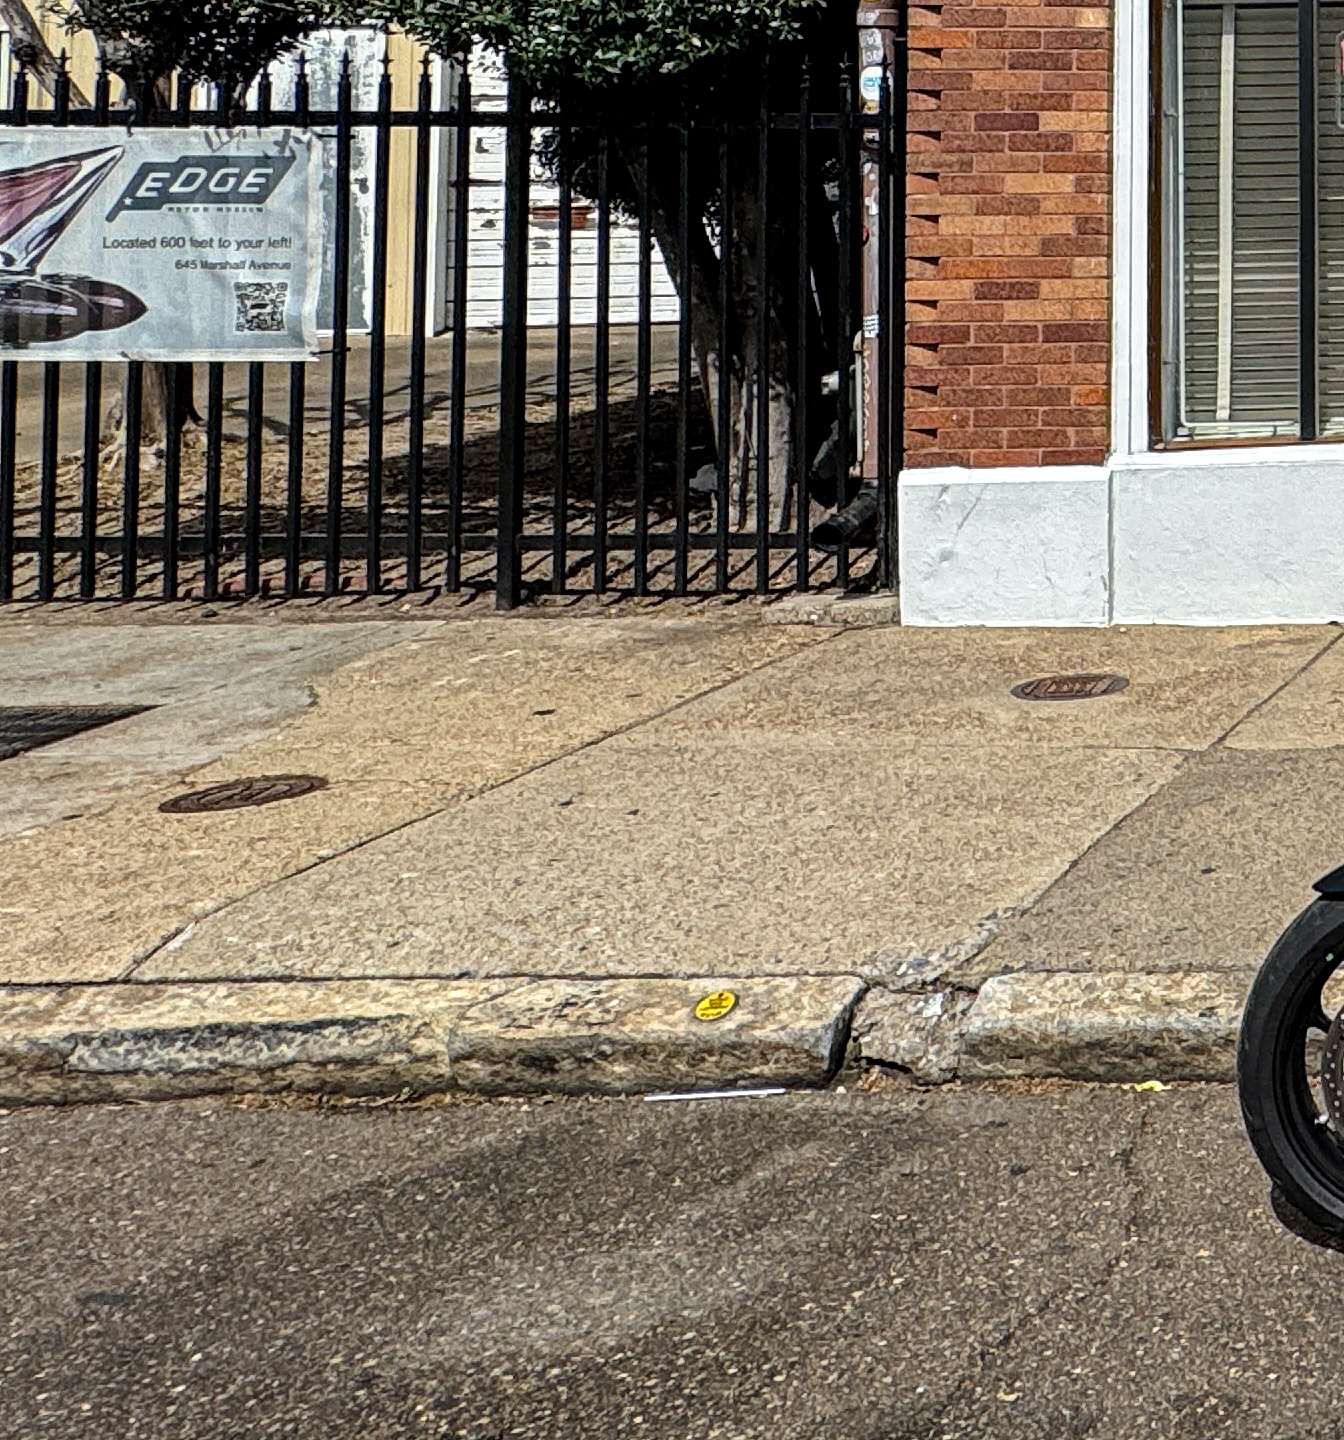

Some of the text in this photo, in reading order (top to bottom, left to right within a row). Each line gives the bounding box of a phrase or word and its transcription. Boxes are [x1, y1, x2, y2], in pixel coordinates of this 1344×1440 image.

[135, 167, 273, 198] EDGE
[102, 237, 157, 249] Located
[160, 237, 186, 248] 600
[190, 237, 213, 248] feet
[218, 237, 231, 248] to
[235, 239, 264, 251] your
[174, 260, 198, 270] 645
[250, 261, 291, 271] Avenue
